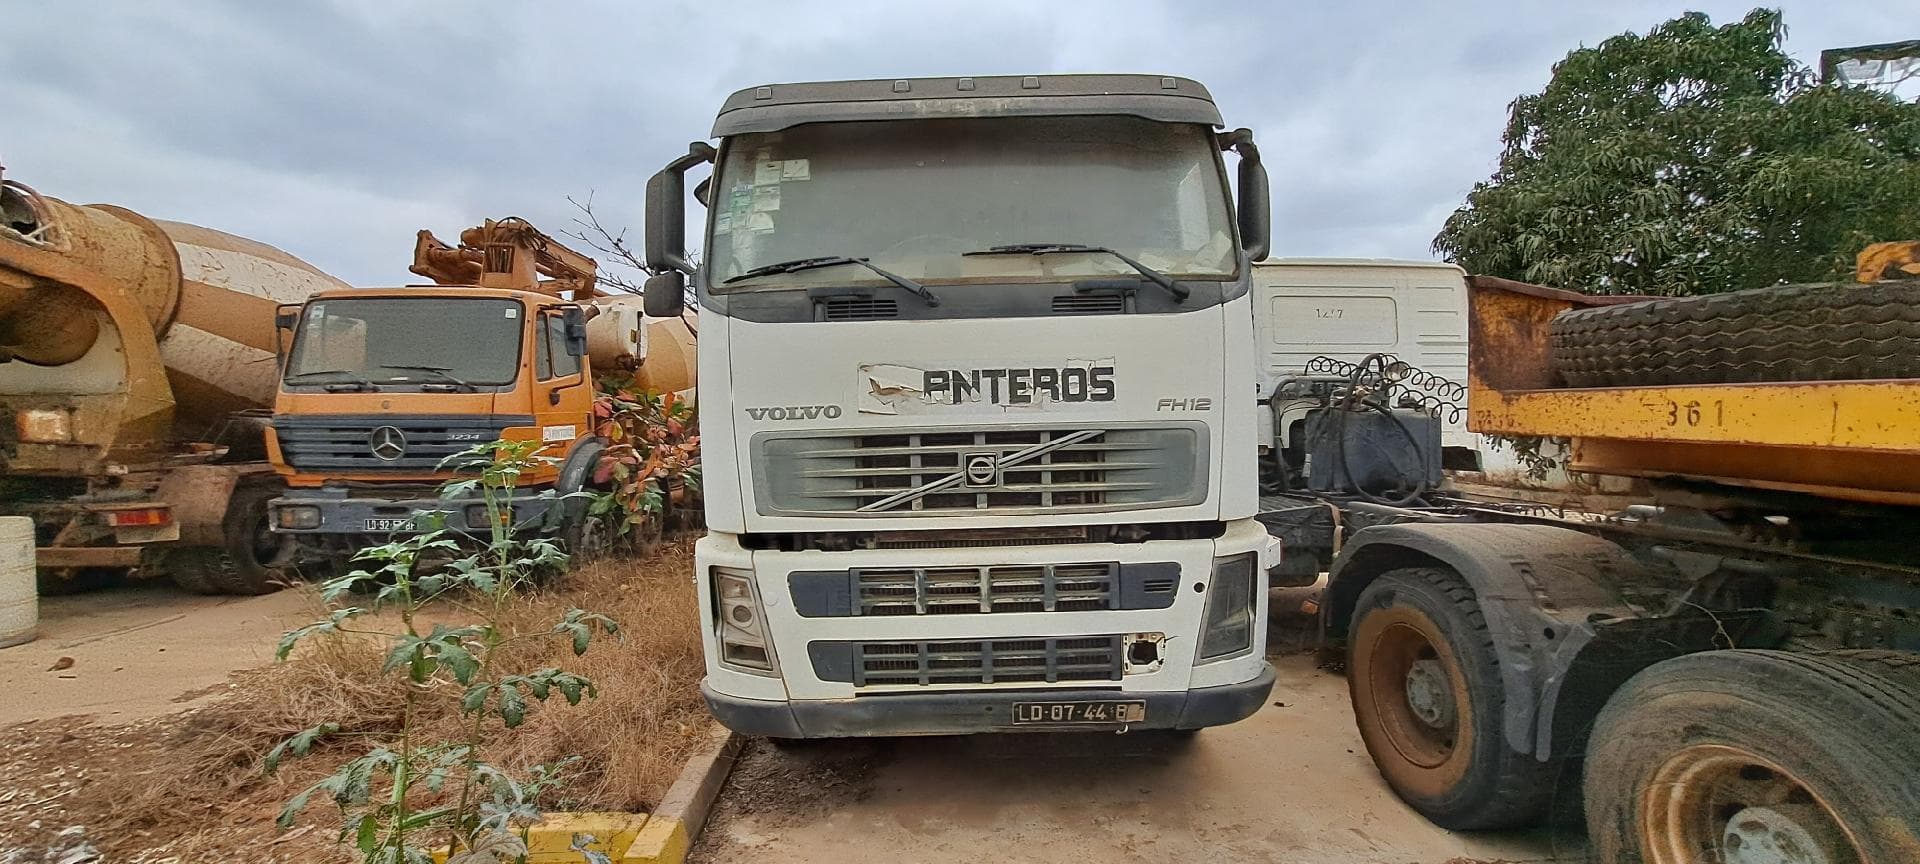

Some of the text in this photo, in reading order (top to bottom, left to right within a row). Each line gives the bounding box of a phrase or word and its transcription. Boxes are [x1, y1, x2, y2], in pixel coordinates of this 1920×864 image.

[923, 367, 1115, 405] ANTEROS
[745, 405, 842, 420] VOLVO
[1157, 398, 1211, 411] FH12
[1667, 400, 1722, 426] 361
